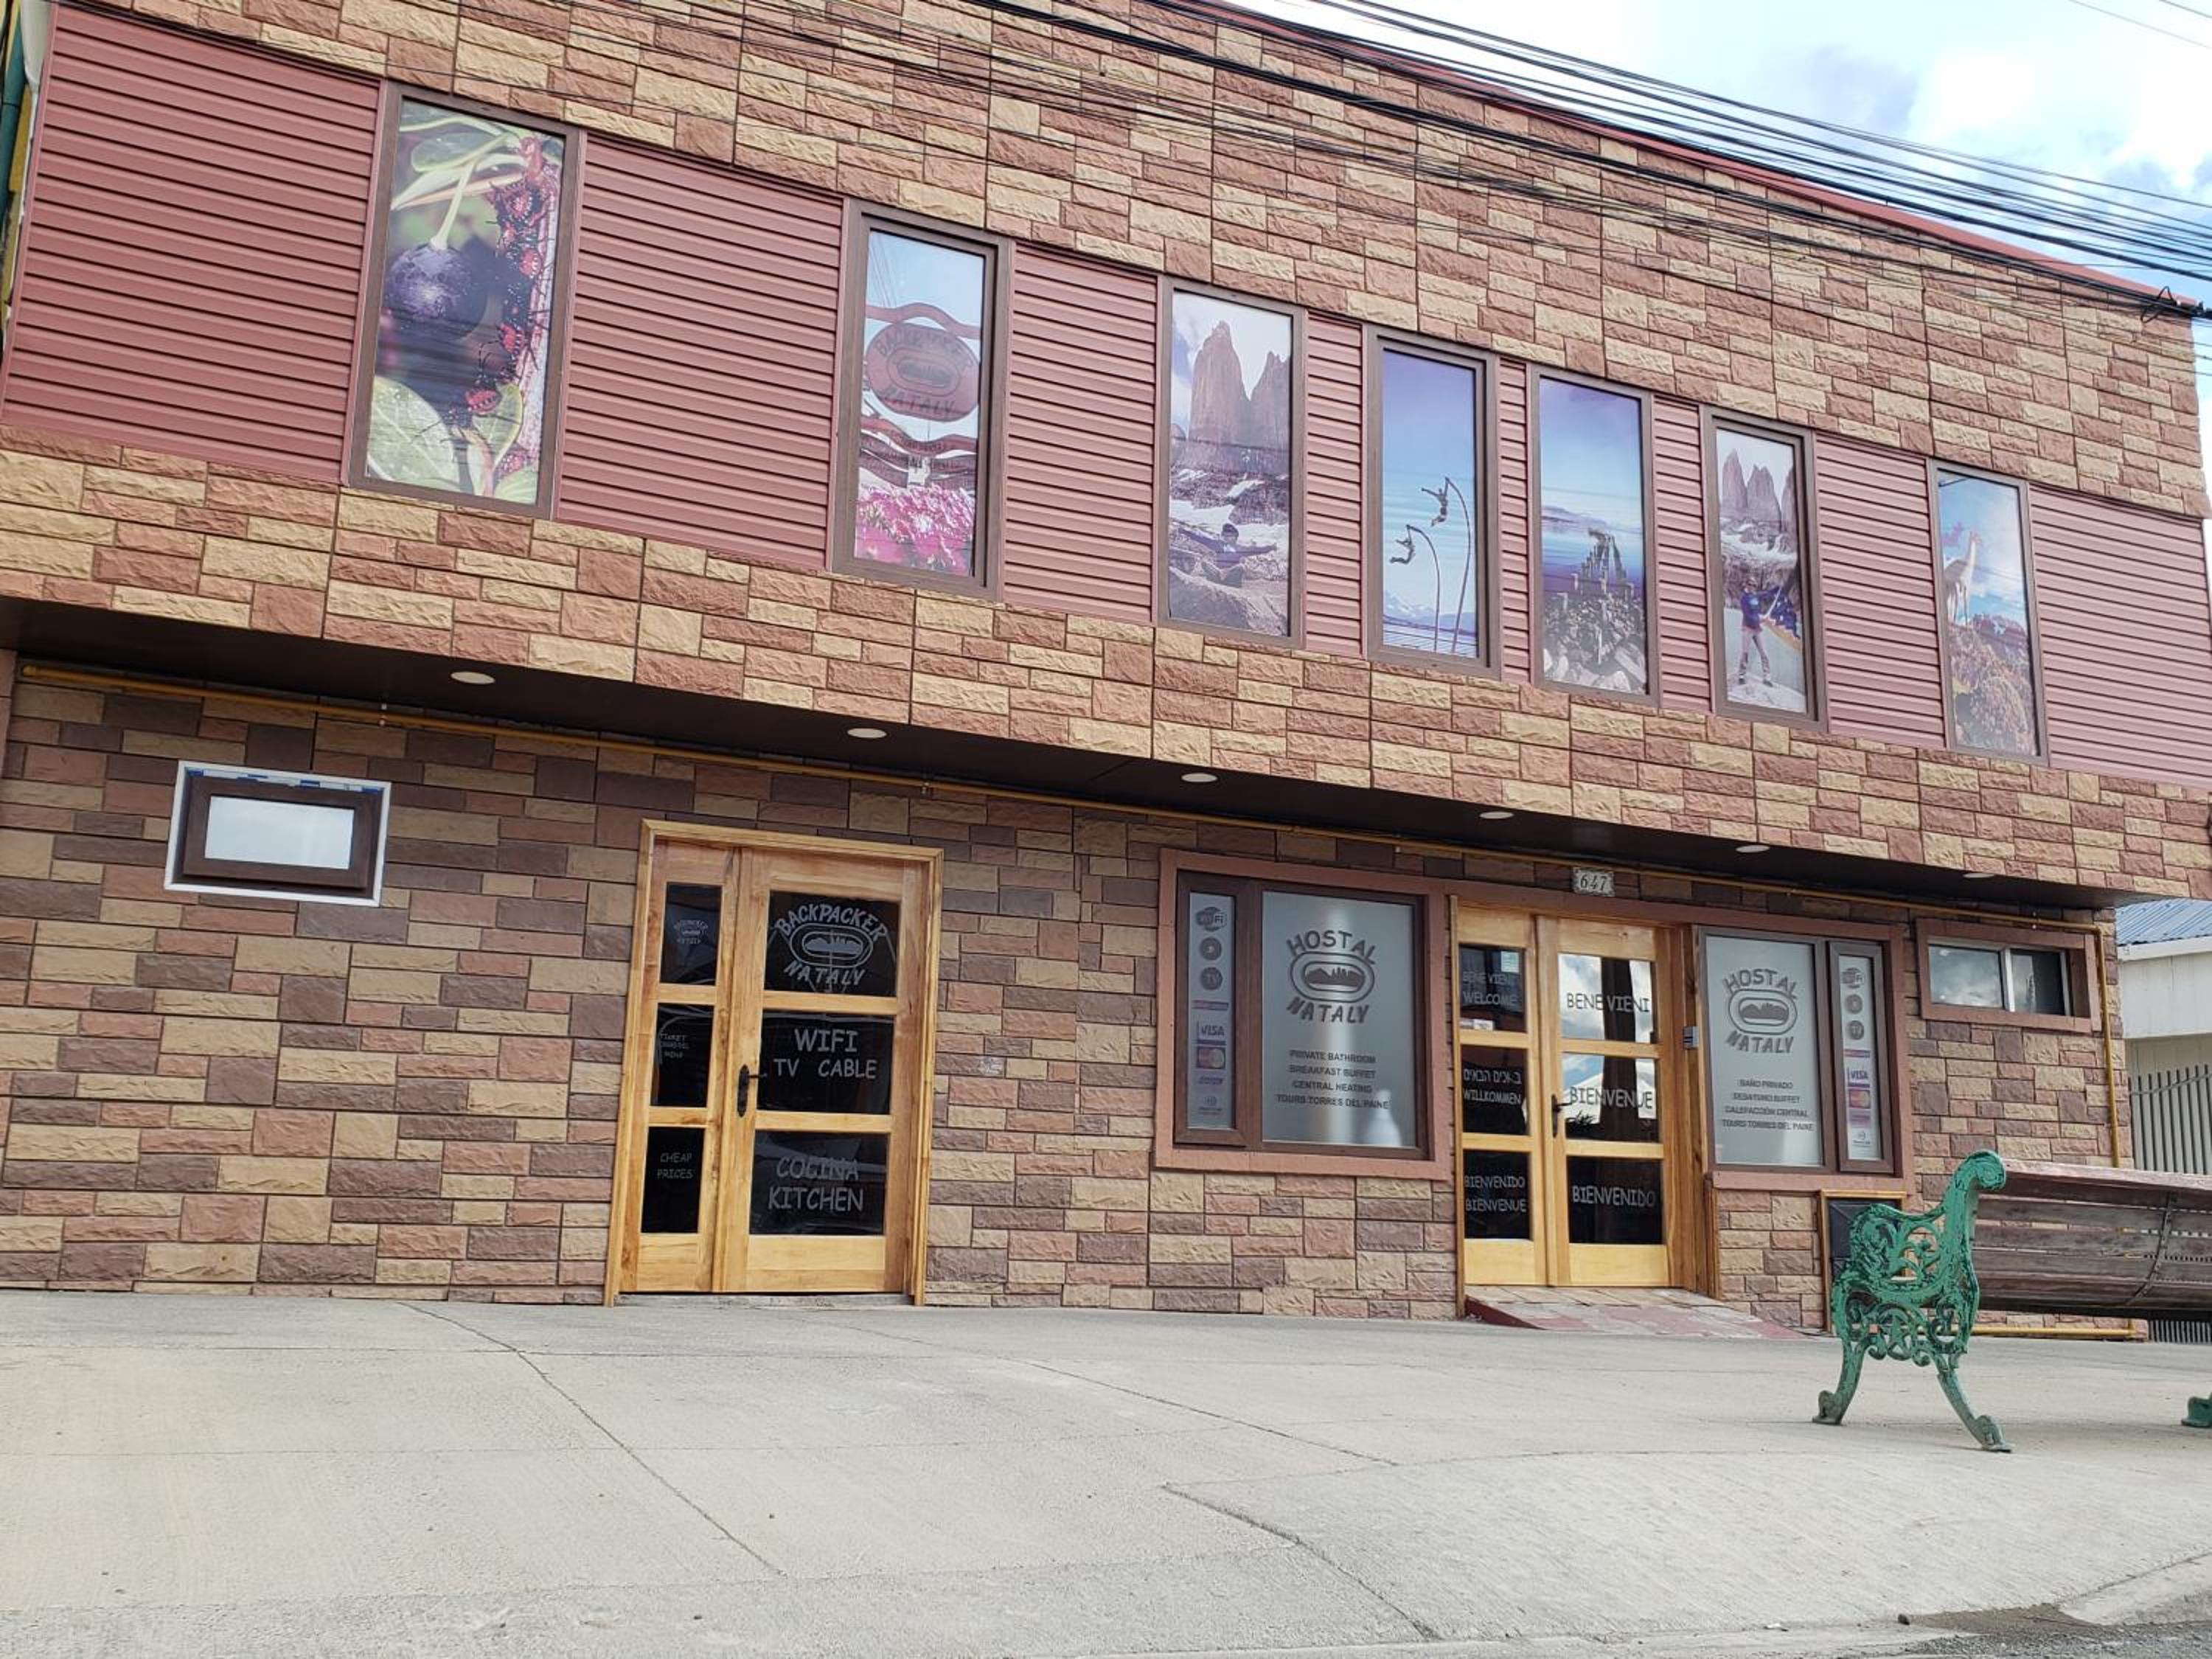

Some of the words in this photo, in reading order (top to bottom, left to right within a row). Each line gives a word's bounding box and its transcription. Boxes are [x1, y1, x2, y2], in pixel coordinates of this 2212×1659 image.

[1580, 874, 1607, 891] 647
[775, 903, 888, 942] BACKPACKER
[1286, 930, 1376, 965] HOSTAL
[784, 961, 866, 985] NATALY
[1722, 968, 1798, 1000] HOSTAL
[1463, 991, 1517, 1006] WELCOME
[1286, 996, 1369, 1023] NATALY
[1201, 1024, 1225, 1036] VISA
[794, 1029, 858, 1052] WIFI
[1726, 1030, 1794, 1054] NATALY
[1290, 1049, 1326, 1060] PRIVATE
[1328, 1052, 1376, 1064] BATHROOM
[773, 1058, 800, 1078] TV
[818, 1058, 877, 1079] CABLE
[1288, 1064, 1340, 1077] BREAKFAST
[1343, 1068, 1376, 1079] BUFFET
[1851, 1070, 1868, 1079] VISA
[1293, 1080, 1333, 1091] CENTRAL
[1335, 1083, 1373, 1093] HEATING
[1762, 1080, 1793, 1089] PRIVADO
[1276, 1093, 1306, 1104] TOURS
[1309, 1096, 1343, 1107] TORRES
[1463, 1088, 1521, 1105] WILLKOMMEN
[1569, 1086, 1652, 1109] BIENVENUE
[660, 1152, 692, 1163] CHEAP
[657, 1168, 694, 1179] PRICES
[776, 1155, 860, 1180] COCINA
[1464, 1175, 1526, 1189] BIENVENIDO
[768, 1186, 863, 1211] KITCHEN
[1572, 1185, 1656, 1207] BIENVENIDO
[1465, 1198, 1527, 1213] BIENVENUE
